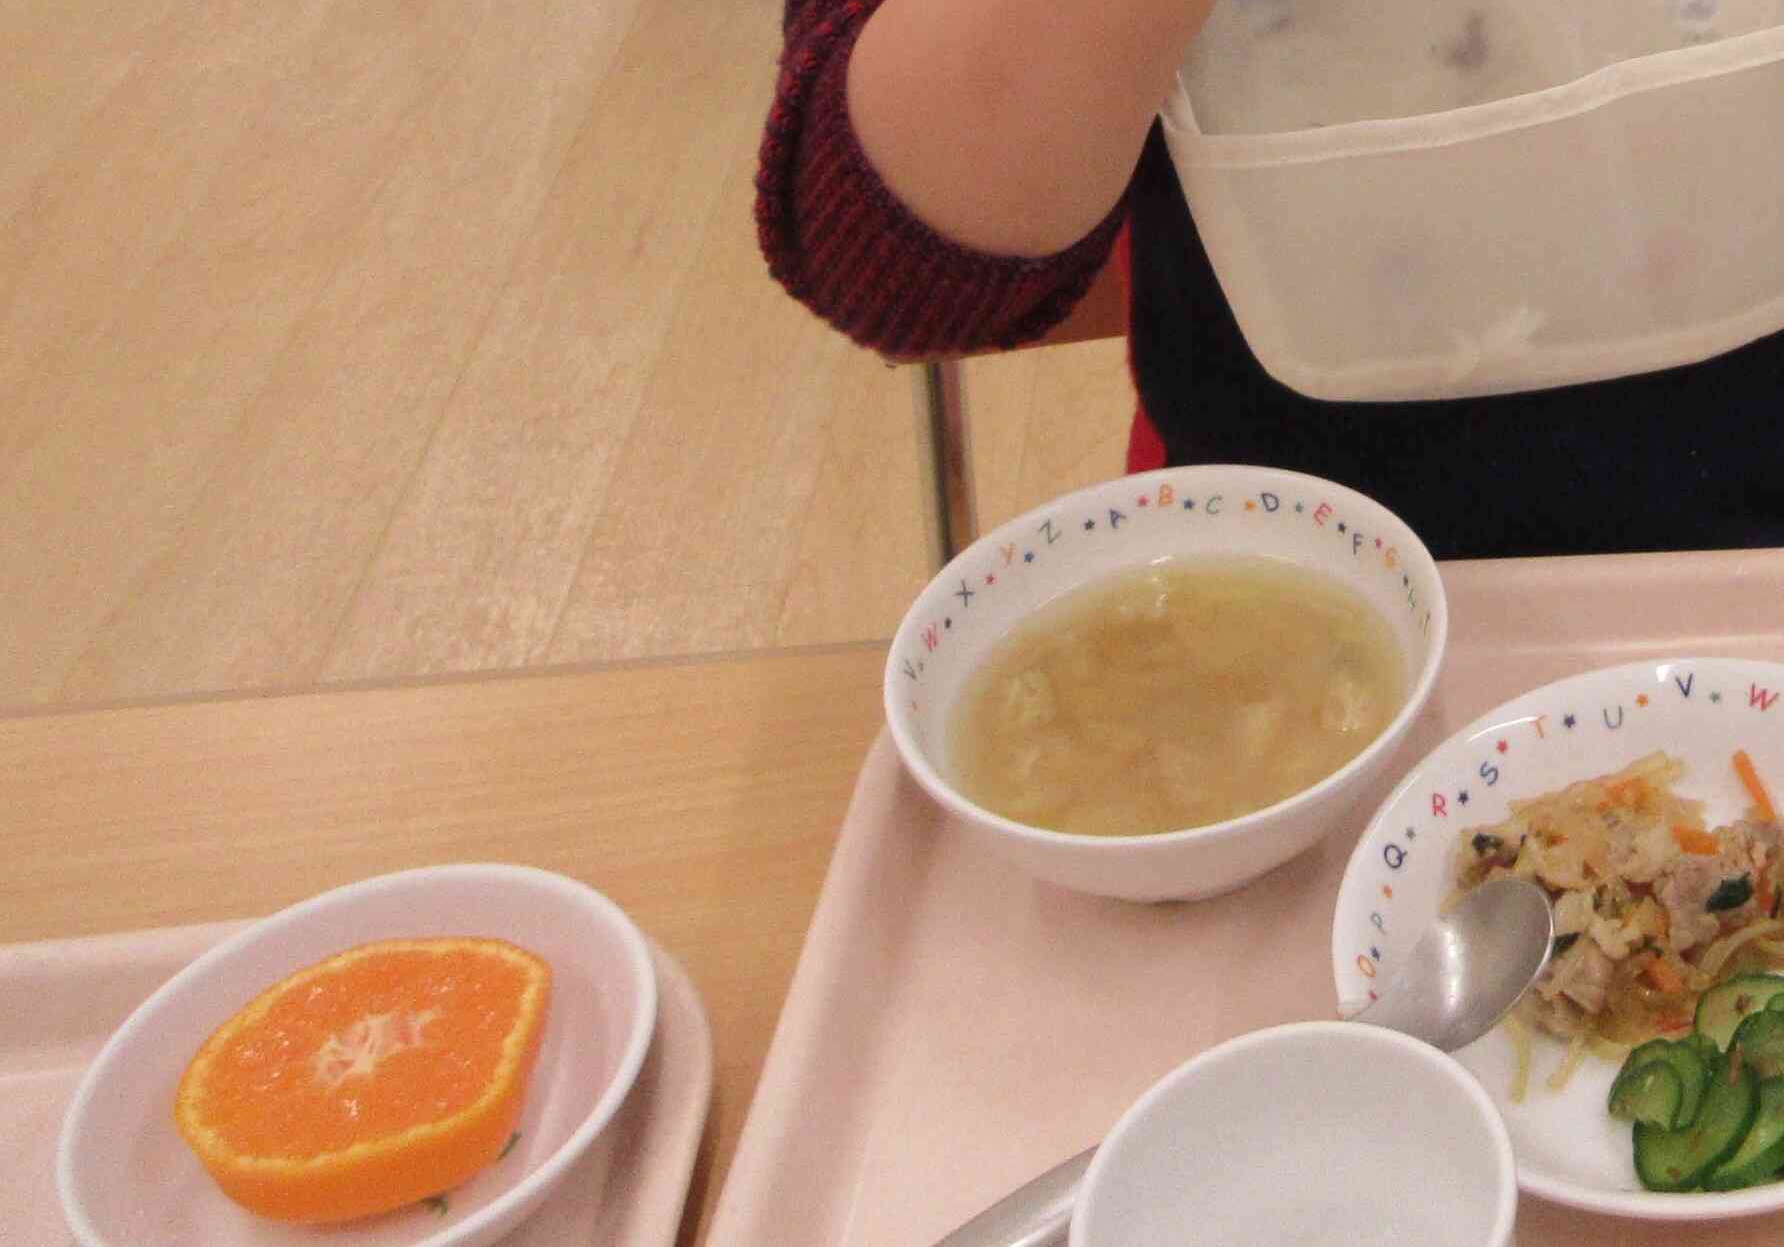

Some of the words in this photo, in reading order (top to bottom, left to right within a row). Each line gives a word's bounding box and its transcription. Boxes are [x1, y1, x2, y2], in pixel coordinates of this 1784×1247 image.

[955, 579, 975, 607] X
[1039, 519, 1063, 544] Z
[1109, 508, 1128, 529] A
[1157, 483, 1174, 506] B
[1206, 495, 1222, 514] C
[1260, 492, 1279, 512] D
[1313, 503, 1336, 525] E
[1353, 532, 1363, 554] F
[1358, 955, 1376, 977] O
[1371, 913, 1386, 935] P
[1384, 844, 1407, 869] Q
[1432, 793, 1448, 817] R
[1480, 761, 1499, 785] S
[1532, 714, 1547, 738] T
[1603, 706, 1623, 729] U
[1675, 673, 1694, 697] V
[1749, 683, 1779, 712] W
